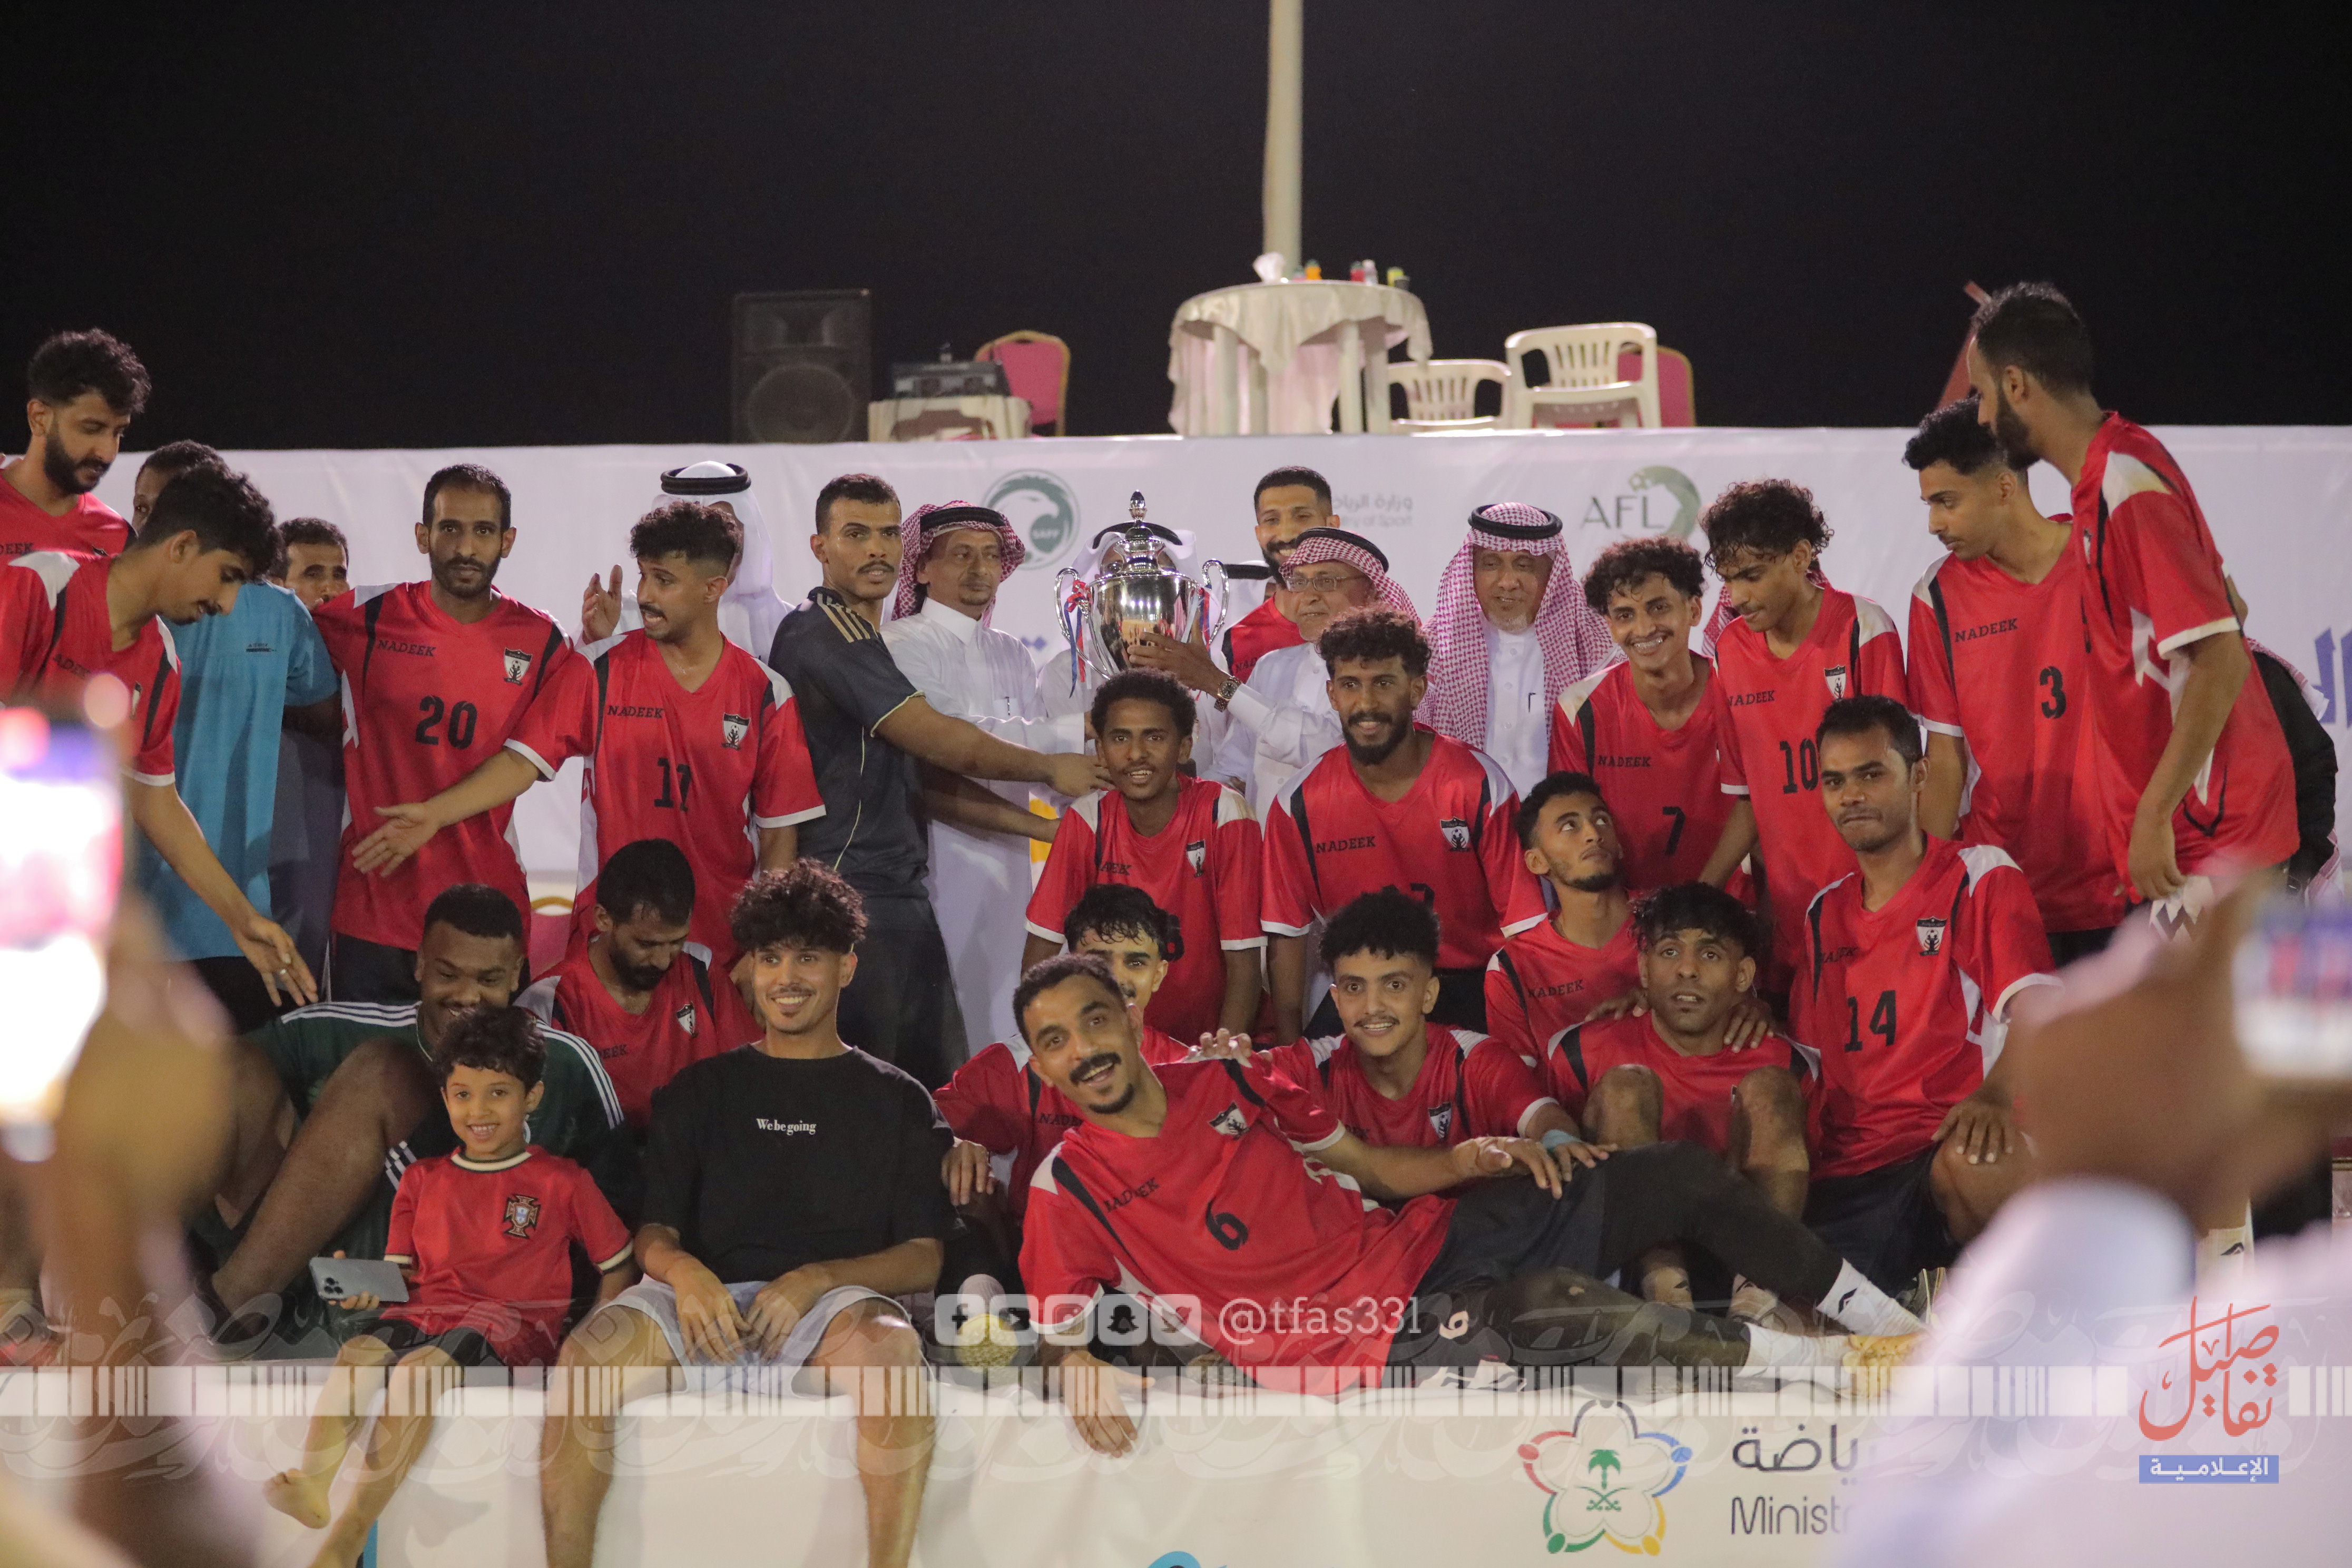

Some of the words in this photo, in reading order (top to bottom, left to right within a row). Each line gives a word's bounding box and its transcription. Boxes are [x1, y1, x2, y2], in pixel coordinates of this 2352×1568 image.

[1580, 495, 1666, 529] AFL
[1955, 618, 2018, 642] NADEEK
[378, 639, 436, 657] NADEEK
[2040, 666, 2067, 719] 3
[415, 695, 477, 750] 20
[607, 705, 664, 719] NADEEK
[1599, 755, 1651, 767] NADEEK
[1779, 738, 1818, 794] 10
[1316, 836, 1376, 854] NADEEK
[1663, 806, 1686, 856] 7
[1528, 979, 1585, 998] NADEEK
[1845, 990, 1896, 1052] 14
[757, 1118, 773, 1131] We
[773, 1119, 787, 1132] be
[787, 1120, 817, 1135] going
[1206, 1197, 1249, 1251] 6
